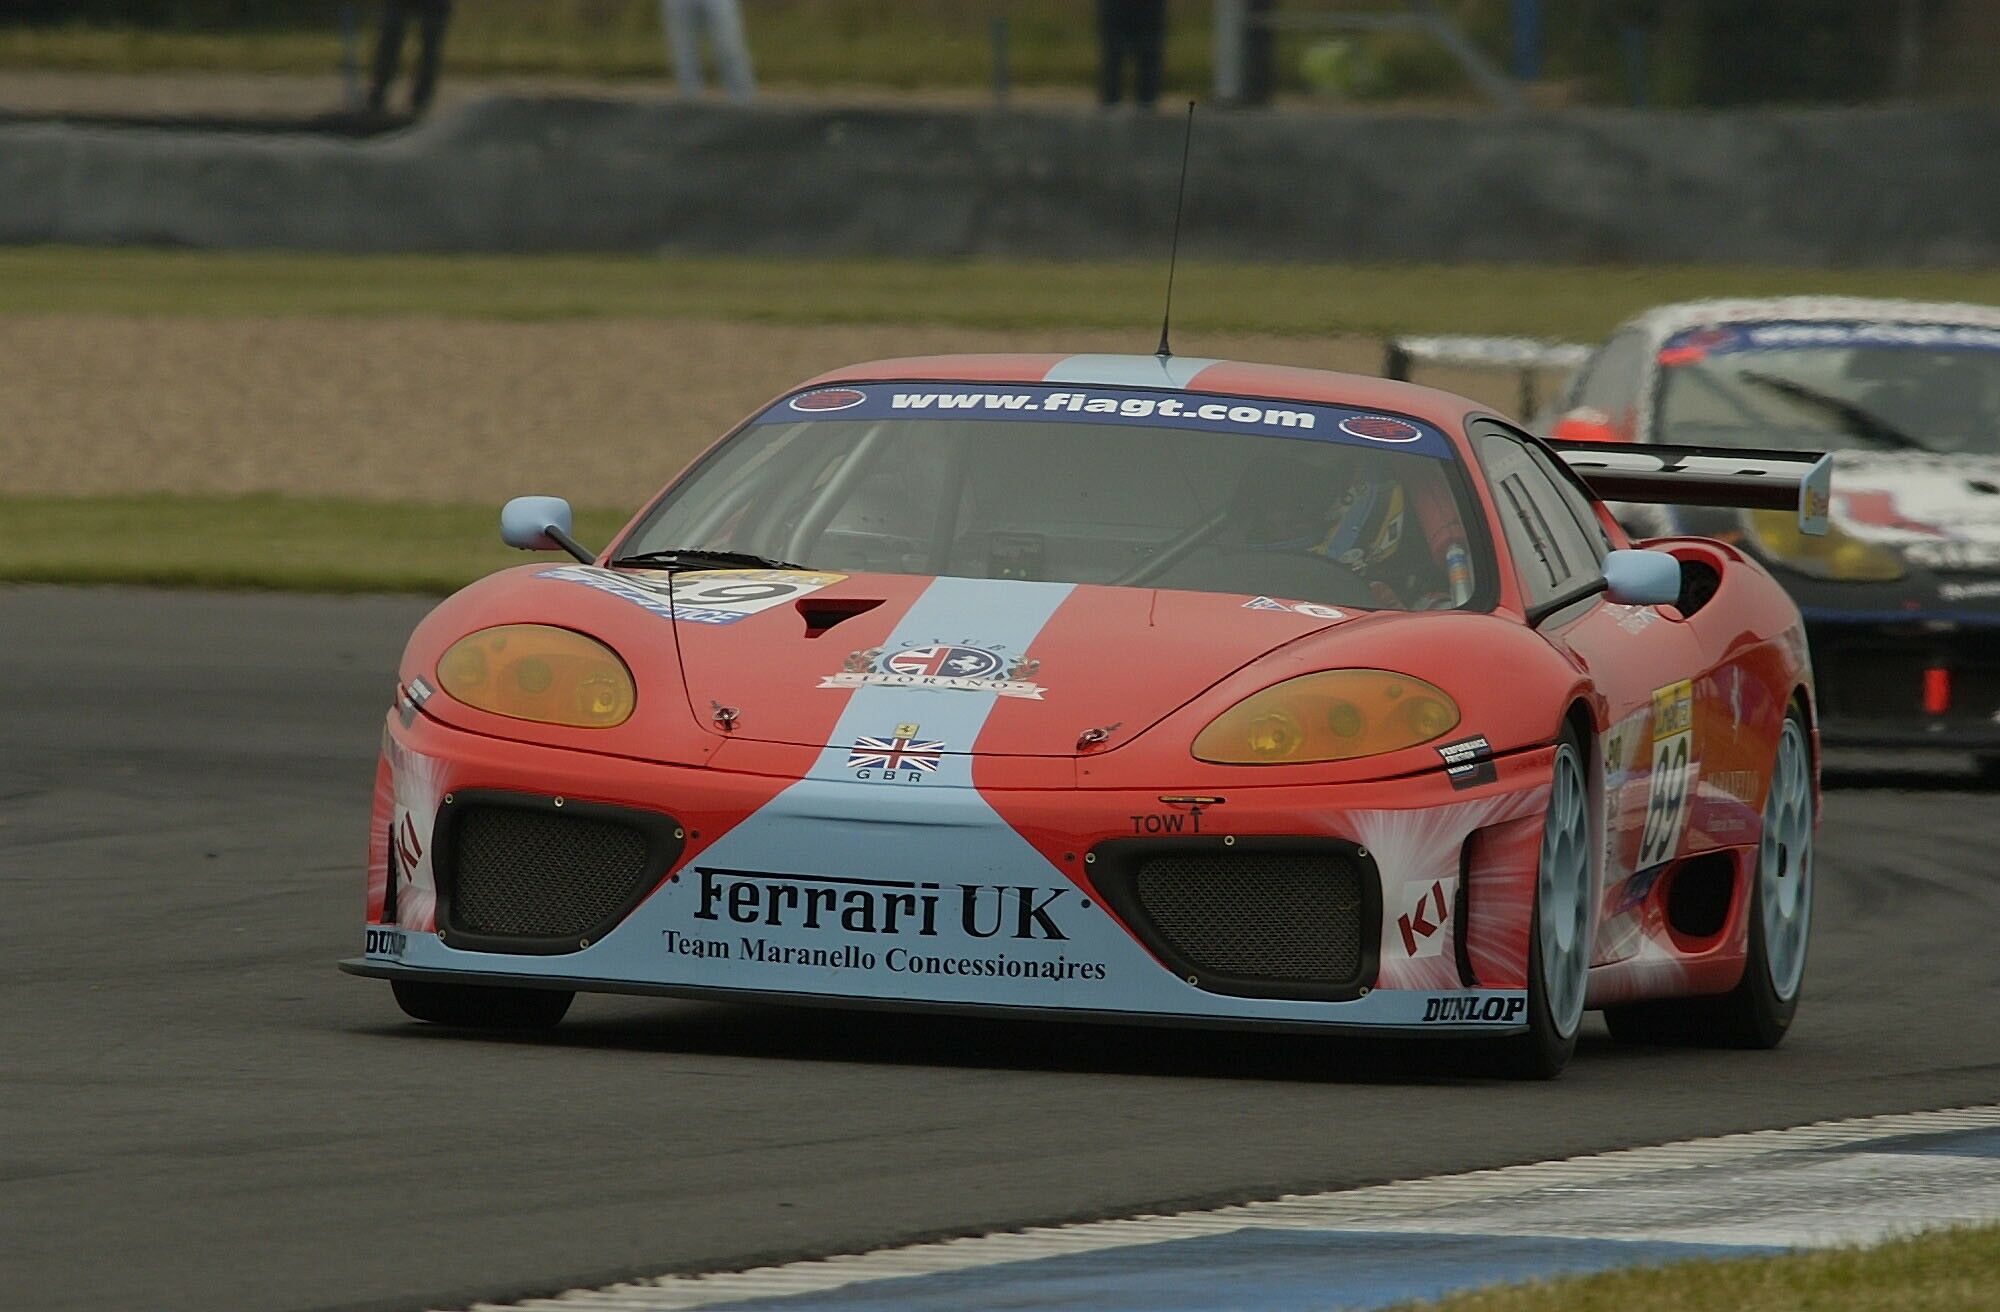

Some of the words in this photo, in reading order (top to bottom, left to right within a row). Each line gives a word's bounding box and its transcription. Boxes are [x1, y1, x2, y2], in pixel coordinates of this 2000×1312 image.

[891, 392, 1316, 429] www.fiagt.com
[901, 638, 1006, 651] CLUB
[862, 674, 1008, 689] FIORANO
[856, 768, 922, 783] GBR
[1130, 814, 1185, 833] TOW
[693, 866, 939, 936] Ferrari
[956, 883, 1071, 941] UK
[1397, 880, 1448, 957] KI
[662, 929, 730, 960] Team
[740, 937, 876, 970] Maranello
[885, 948, 1106, 981] Concessionaires
[1422, 996, 1525, 1021] DUNLOP
